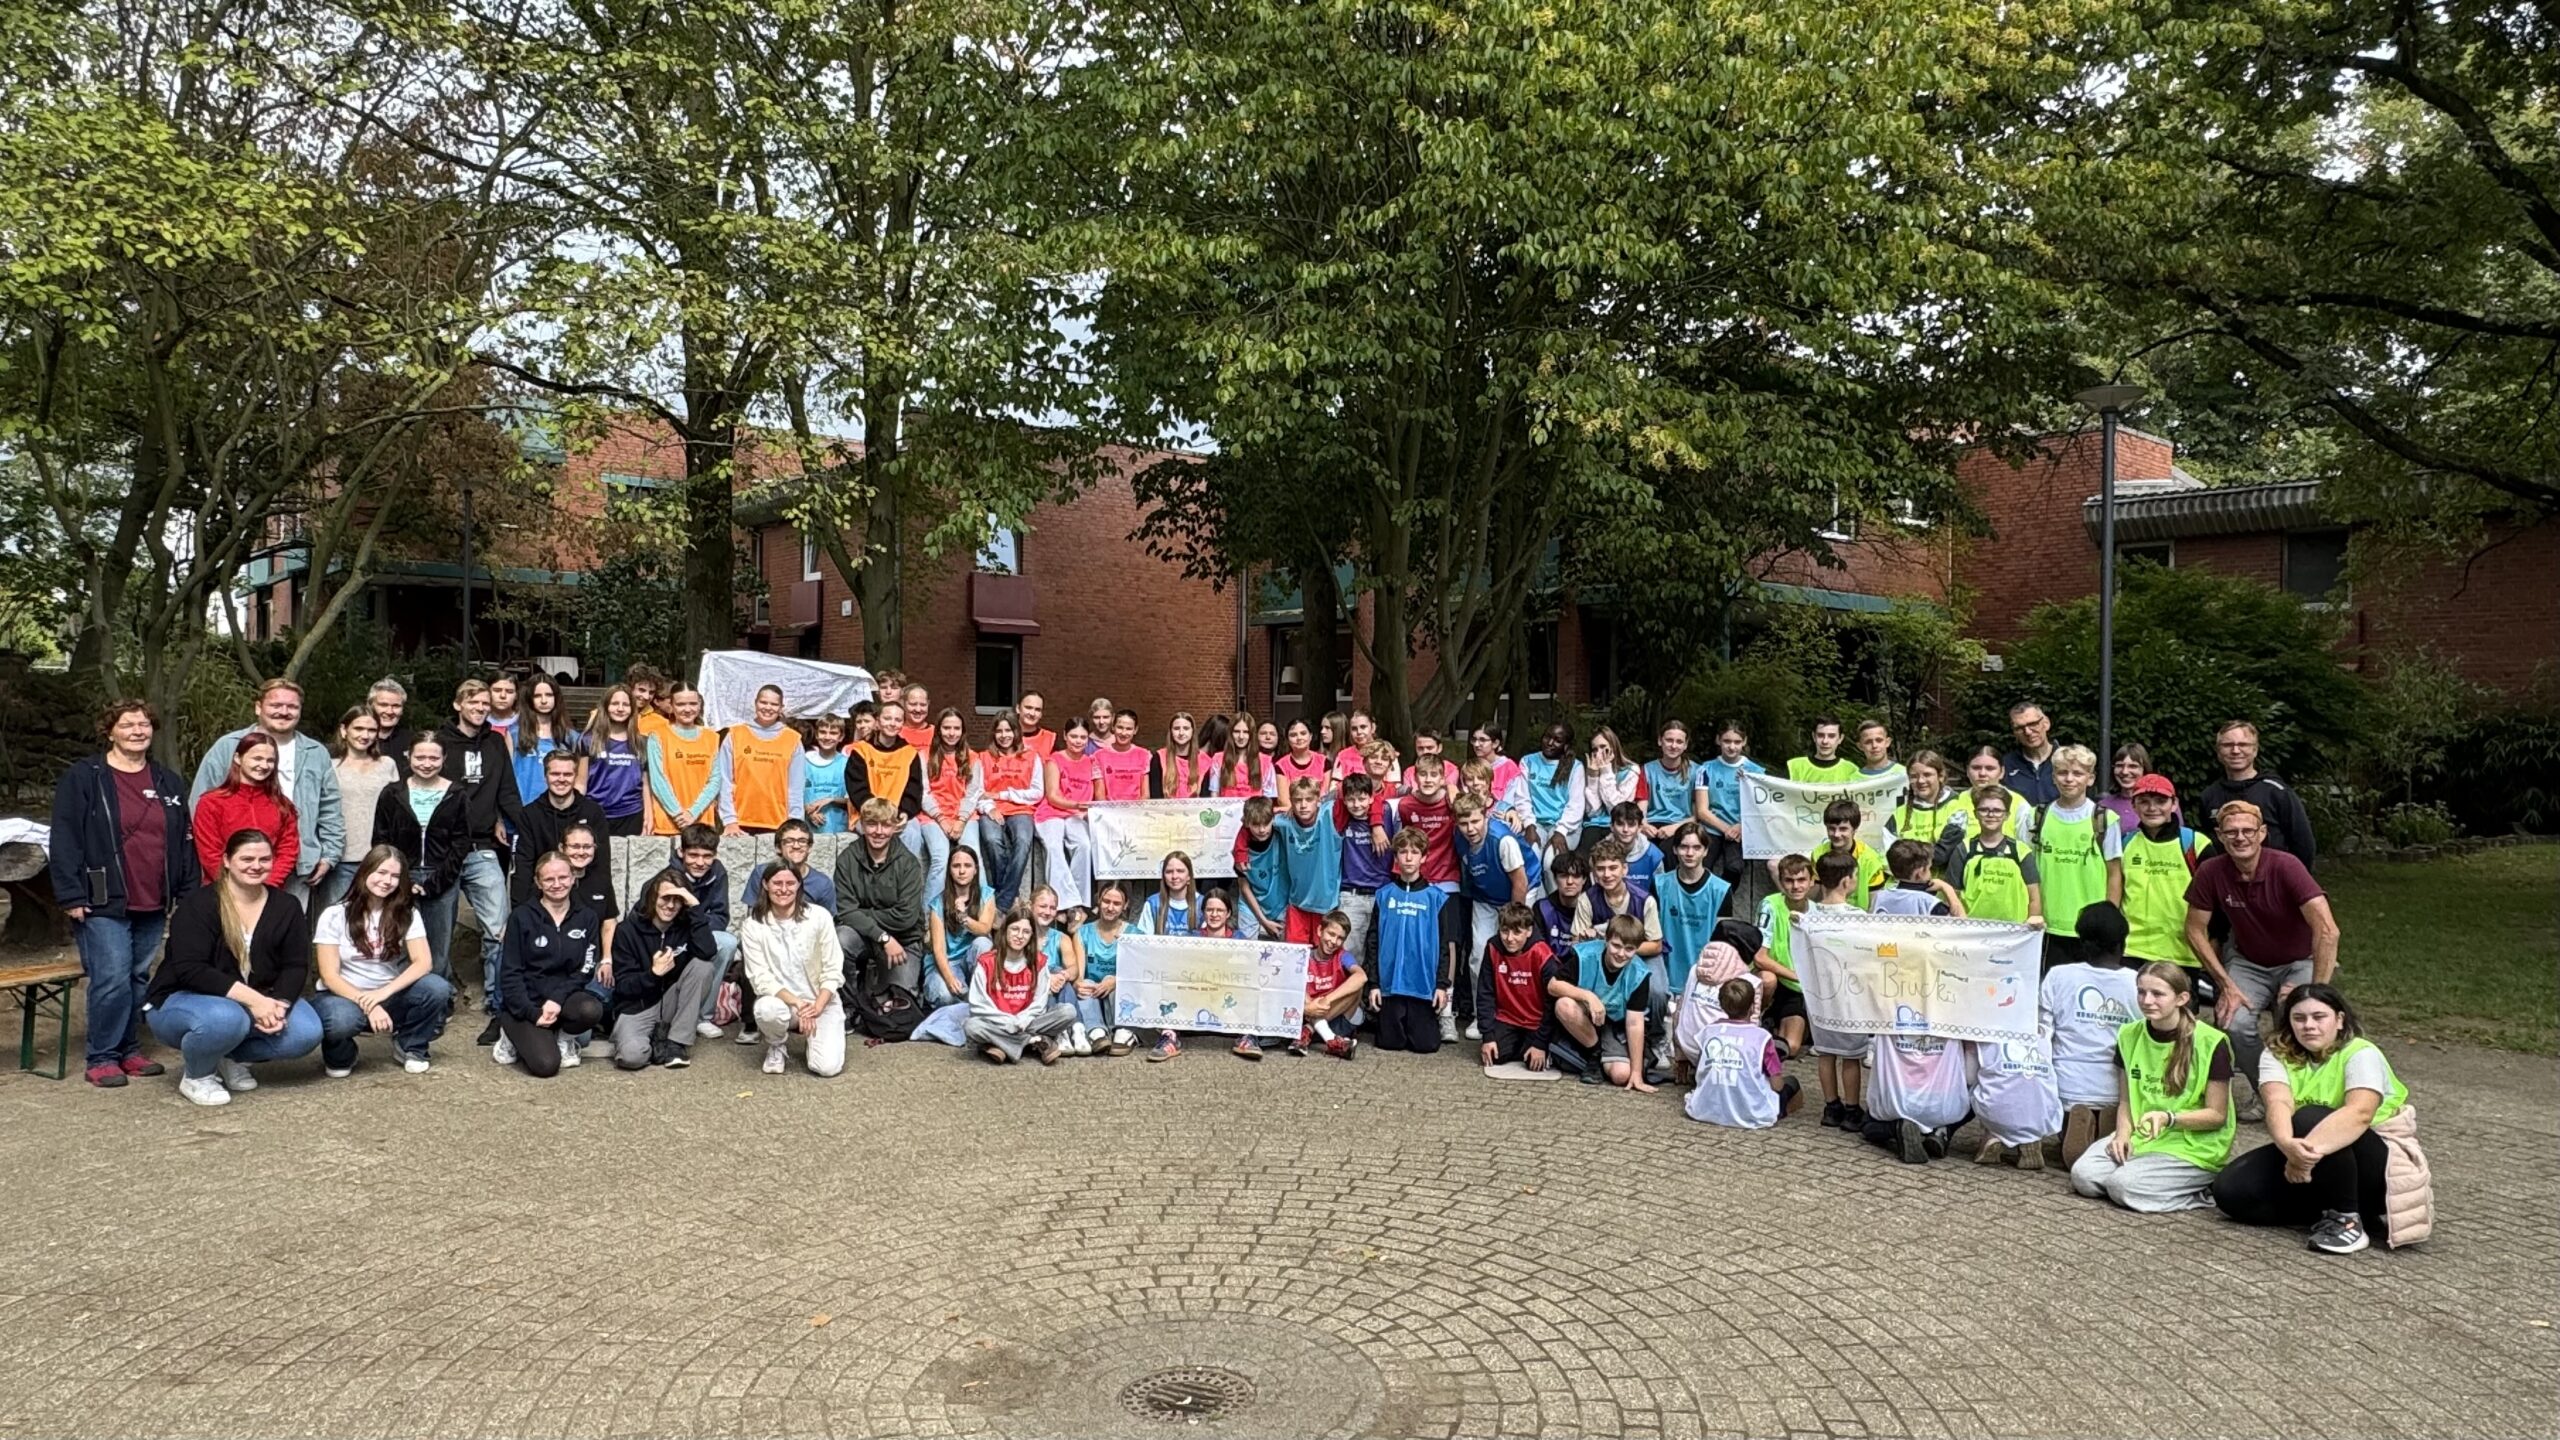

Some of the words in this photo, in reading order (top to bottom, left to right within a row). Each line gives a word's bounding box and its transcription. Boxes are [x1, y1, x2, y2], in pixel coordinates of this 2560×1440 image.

[1754, 786, 1785, 804] Die
[1801, 787, 1897, 805] Uerdinger
[1143, 969, 1168, 982] DIE
[1804, 946, 1864, 1000] Die
